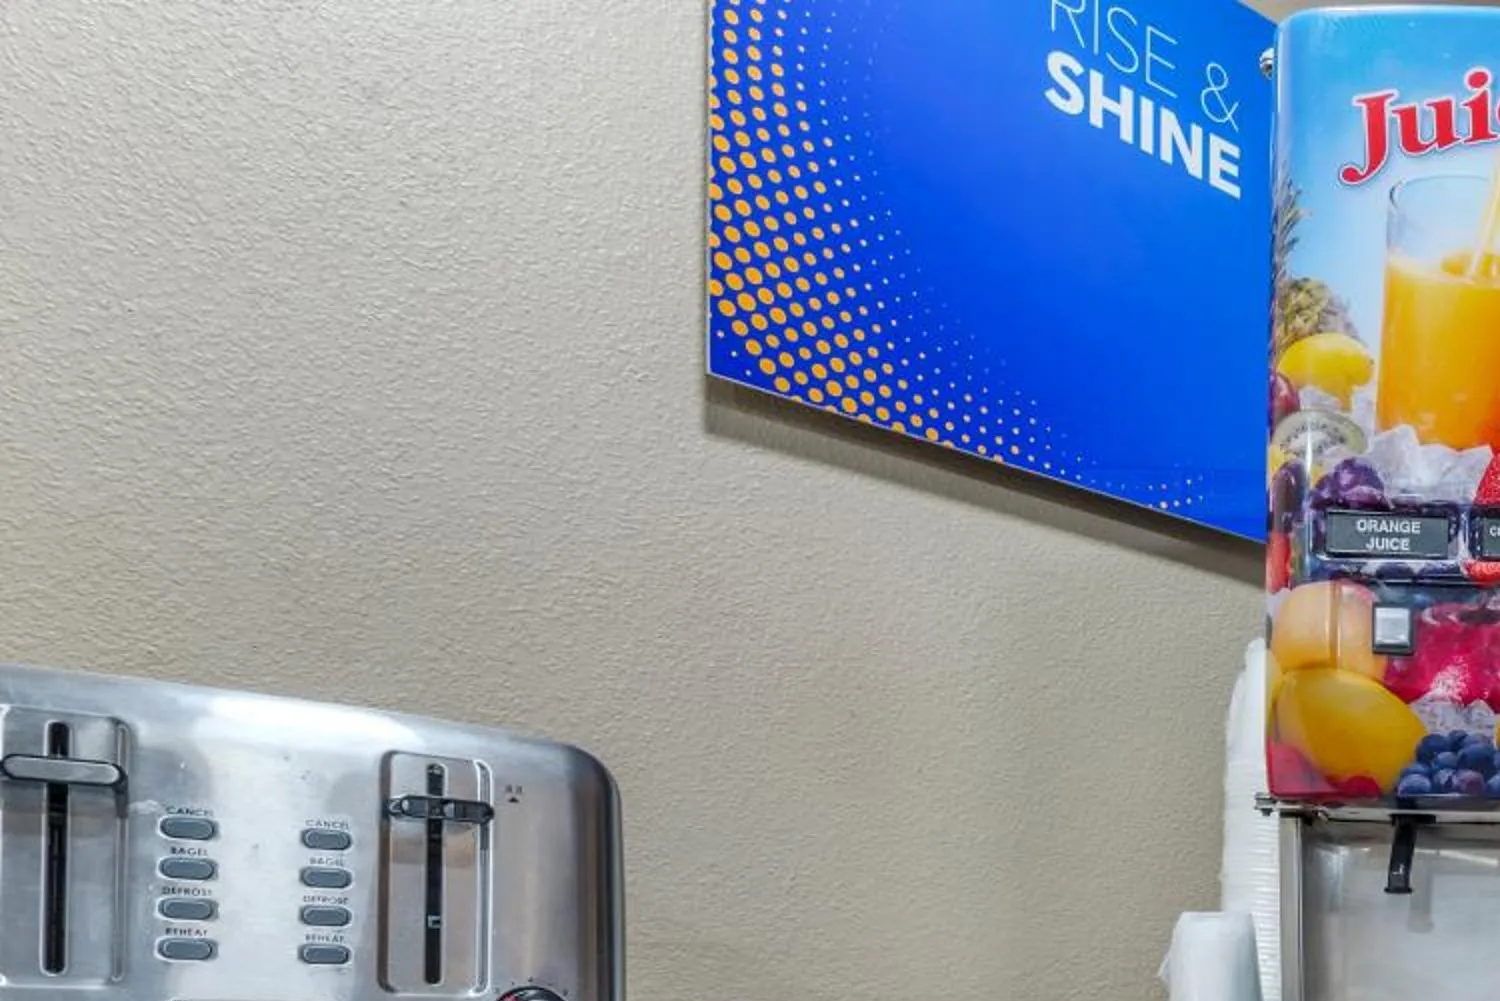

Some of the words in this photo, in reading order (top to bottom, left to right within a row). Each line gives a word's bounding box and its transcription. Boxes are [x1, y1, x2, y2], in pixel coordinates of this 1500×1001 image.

[1050, 0, 1178, 99] RISE
[1201, 62, 1239, 132] &
[1044, 51, 1241, 200] SHINE
[1356, 519, 1421, 535] ORANGE
[1365, 537, 1410, 551] JUICE
